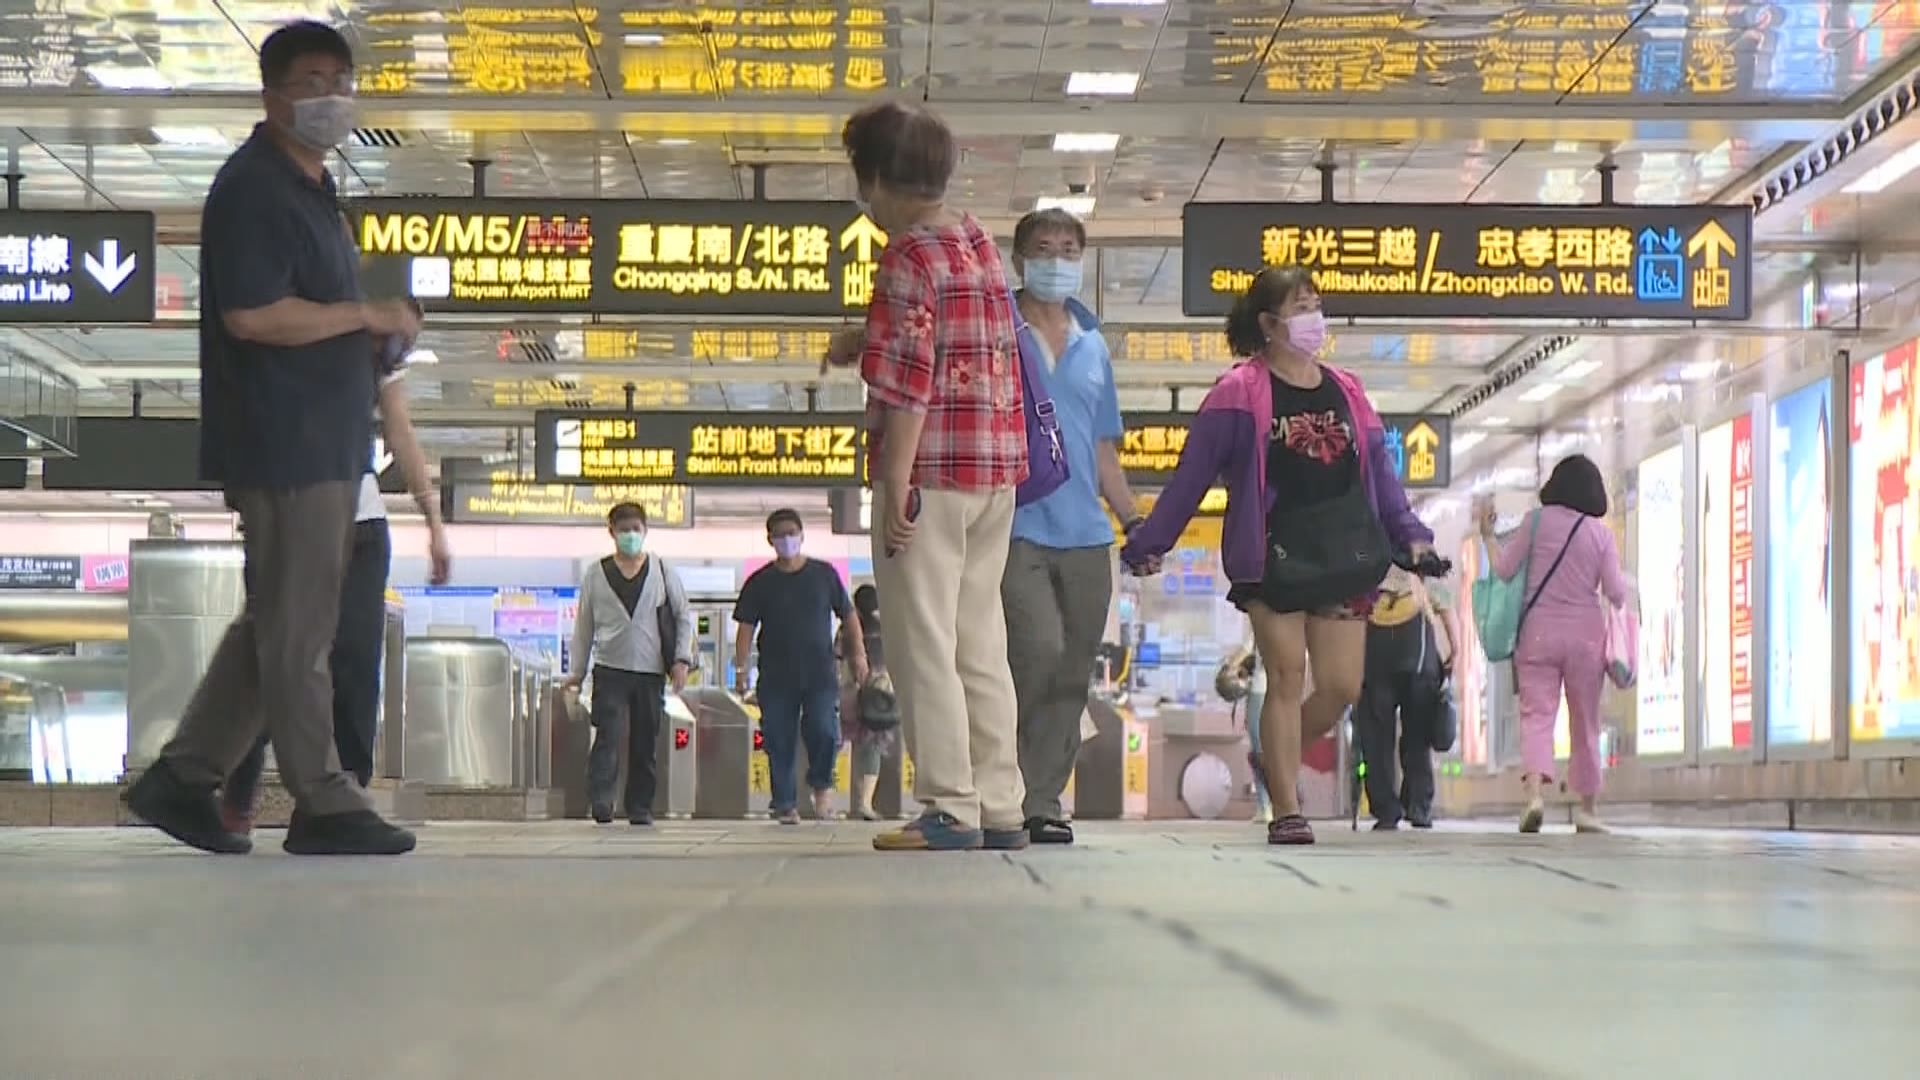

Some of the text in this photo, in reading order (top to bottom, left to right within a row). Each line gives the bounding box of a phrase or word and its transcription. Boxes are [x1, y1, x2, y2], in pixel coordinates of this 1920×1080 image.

[619, 224, 830, 264] 重慶南/北路
[1262, 226, 1417, 266] 新光三越
[1477, 226, 1634, 267] 忠孝西路
[453, 257, 592, 283] 桃園機場捷運
[613, 266, 830, 293] Chongqing S./N. Rd.
[1311, 270, 1417, 291] Mitsukoshi
[29, 279, 71, 302] Line
[453, 283, 592, 300] Taoyuan Airport MRT
[1431, 271, 1634, 297] Zhongxiao W. Rd.
[691, 425, 856, 456] 站前地下街Z
[687, 456, 738, 474] Station
[740, 457, 777, 474] Front
[779, 458, 822, 475] Metro
